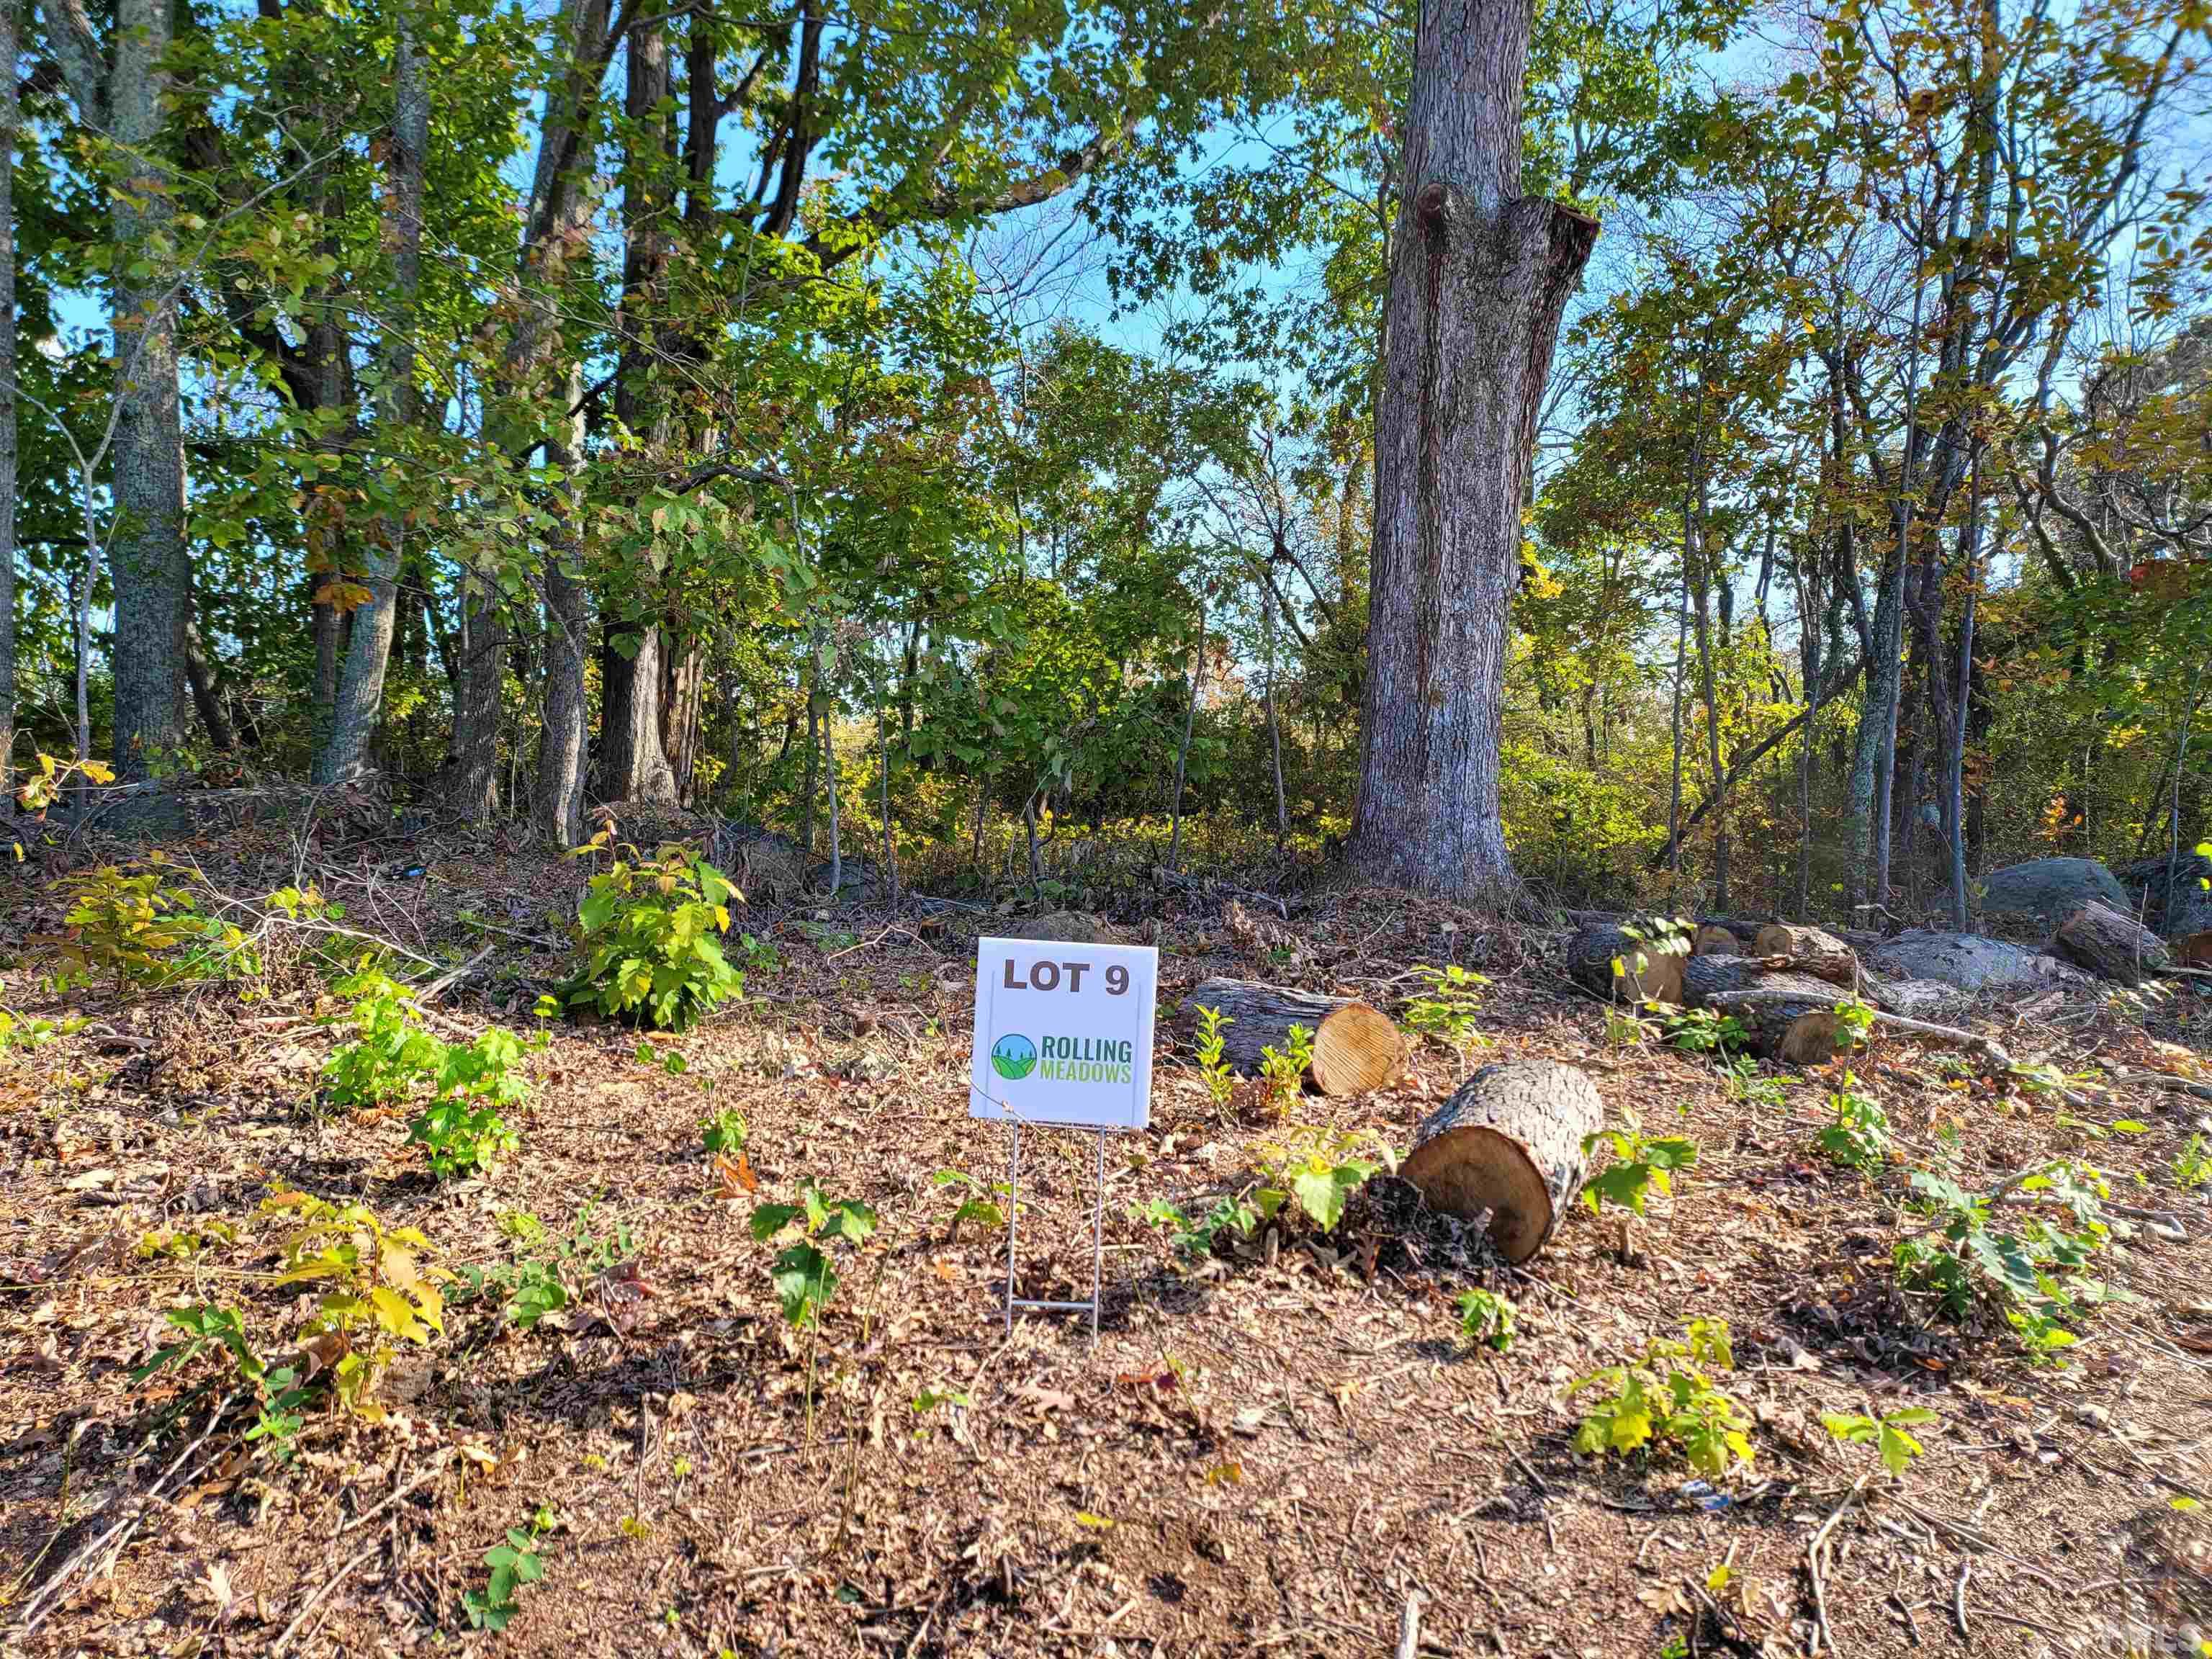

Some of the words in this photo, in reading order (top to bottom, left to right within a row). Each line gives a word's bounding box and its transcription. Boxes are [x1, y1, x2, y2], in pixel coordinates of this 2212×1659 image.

[1004, 959, 1090, 992] LOT
[1105, 965, 1129, 995] 9
[1041, 1036, 1132, 1063] ROLLING
[1040, 1061, 1131, 1084] MEADOWS
